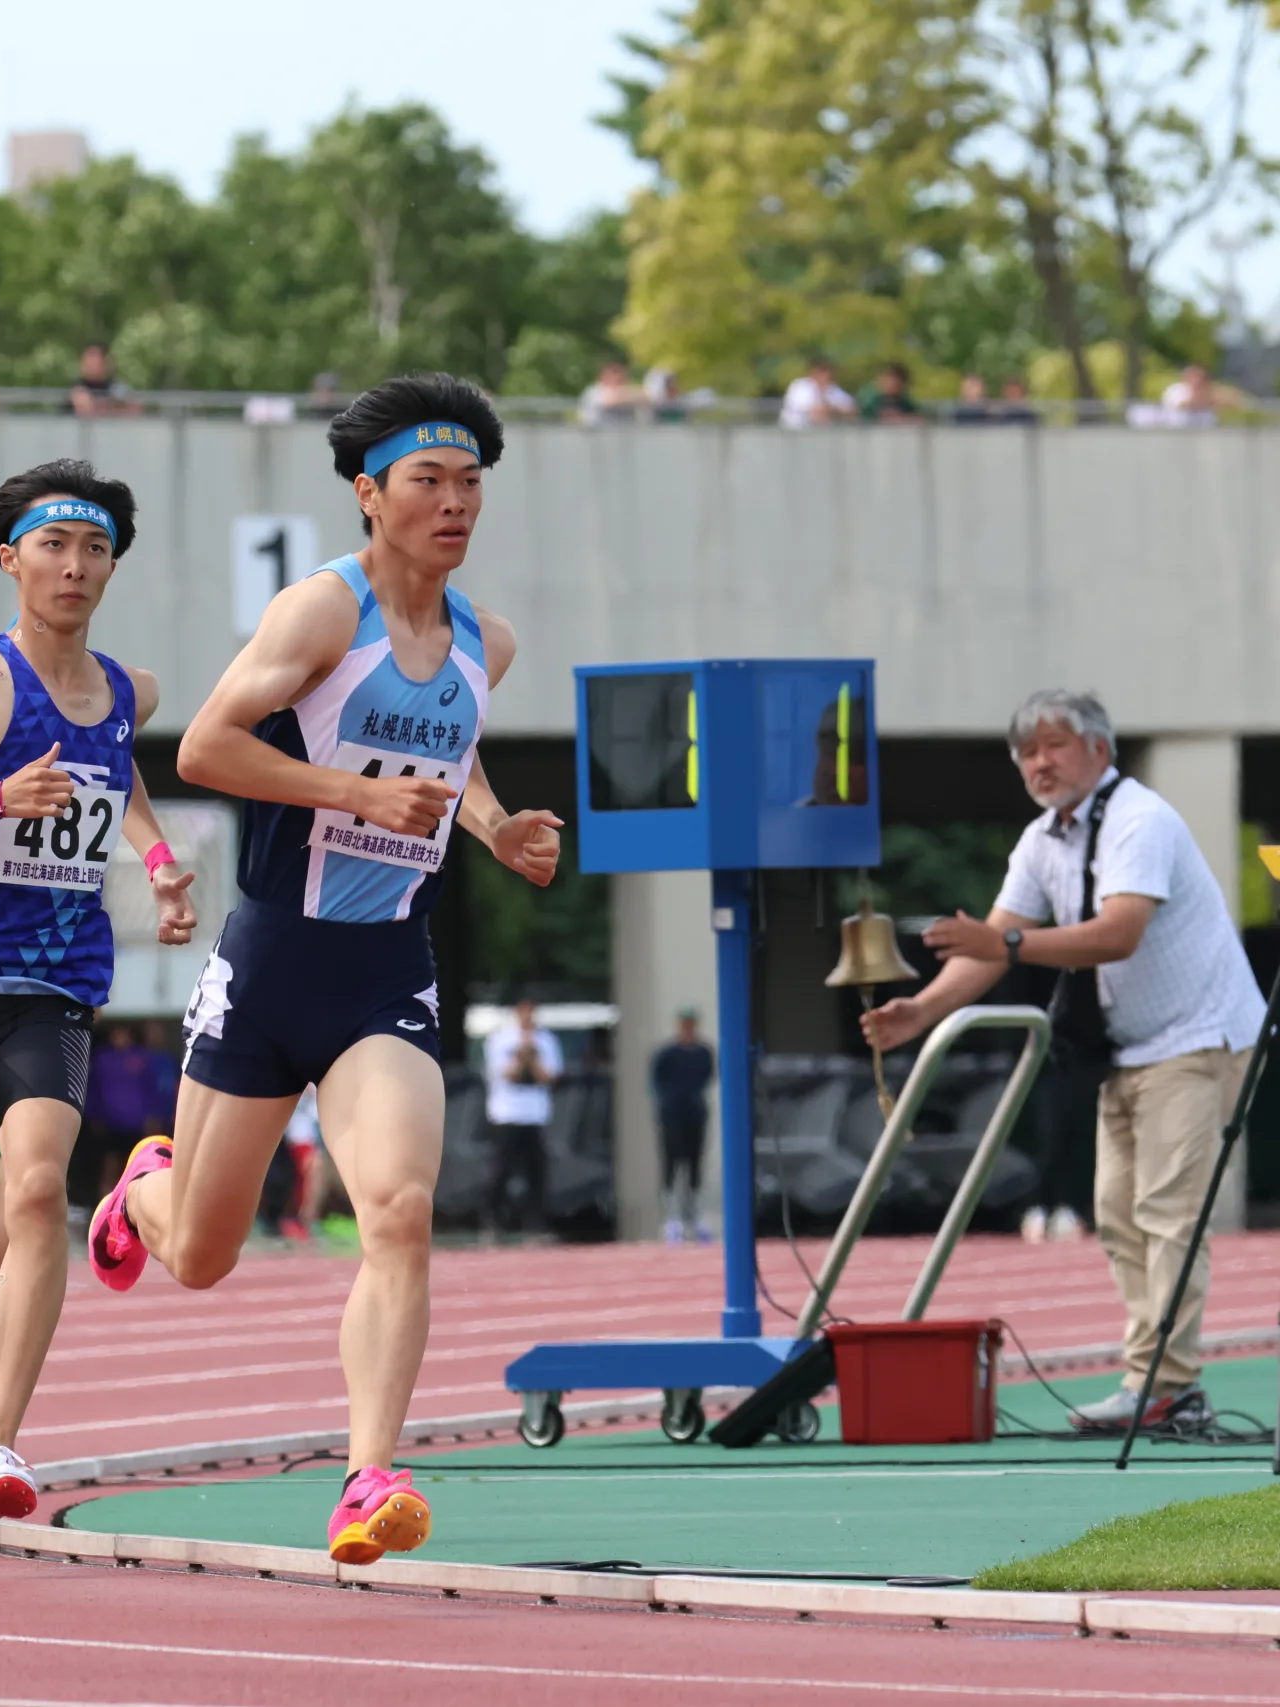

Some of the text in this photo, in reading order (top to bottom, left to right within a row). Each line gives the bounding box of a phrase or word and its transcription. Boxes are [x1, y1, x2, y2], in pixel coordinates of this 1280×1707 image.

[46, 504, 108, 526] 東海大札幌
[360, 708, 462, 752] 札幌開成中等
[13, 796, 113, 863] 482
[322, 825, 440, 866] 第76回北海道高校陸上競技大会
